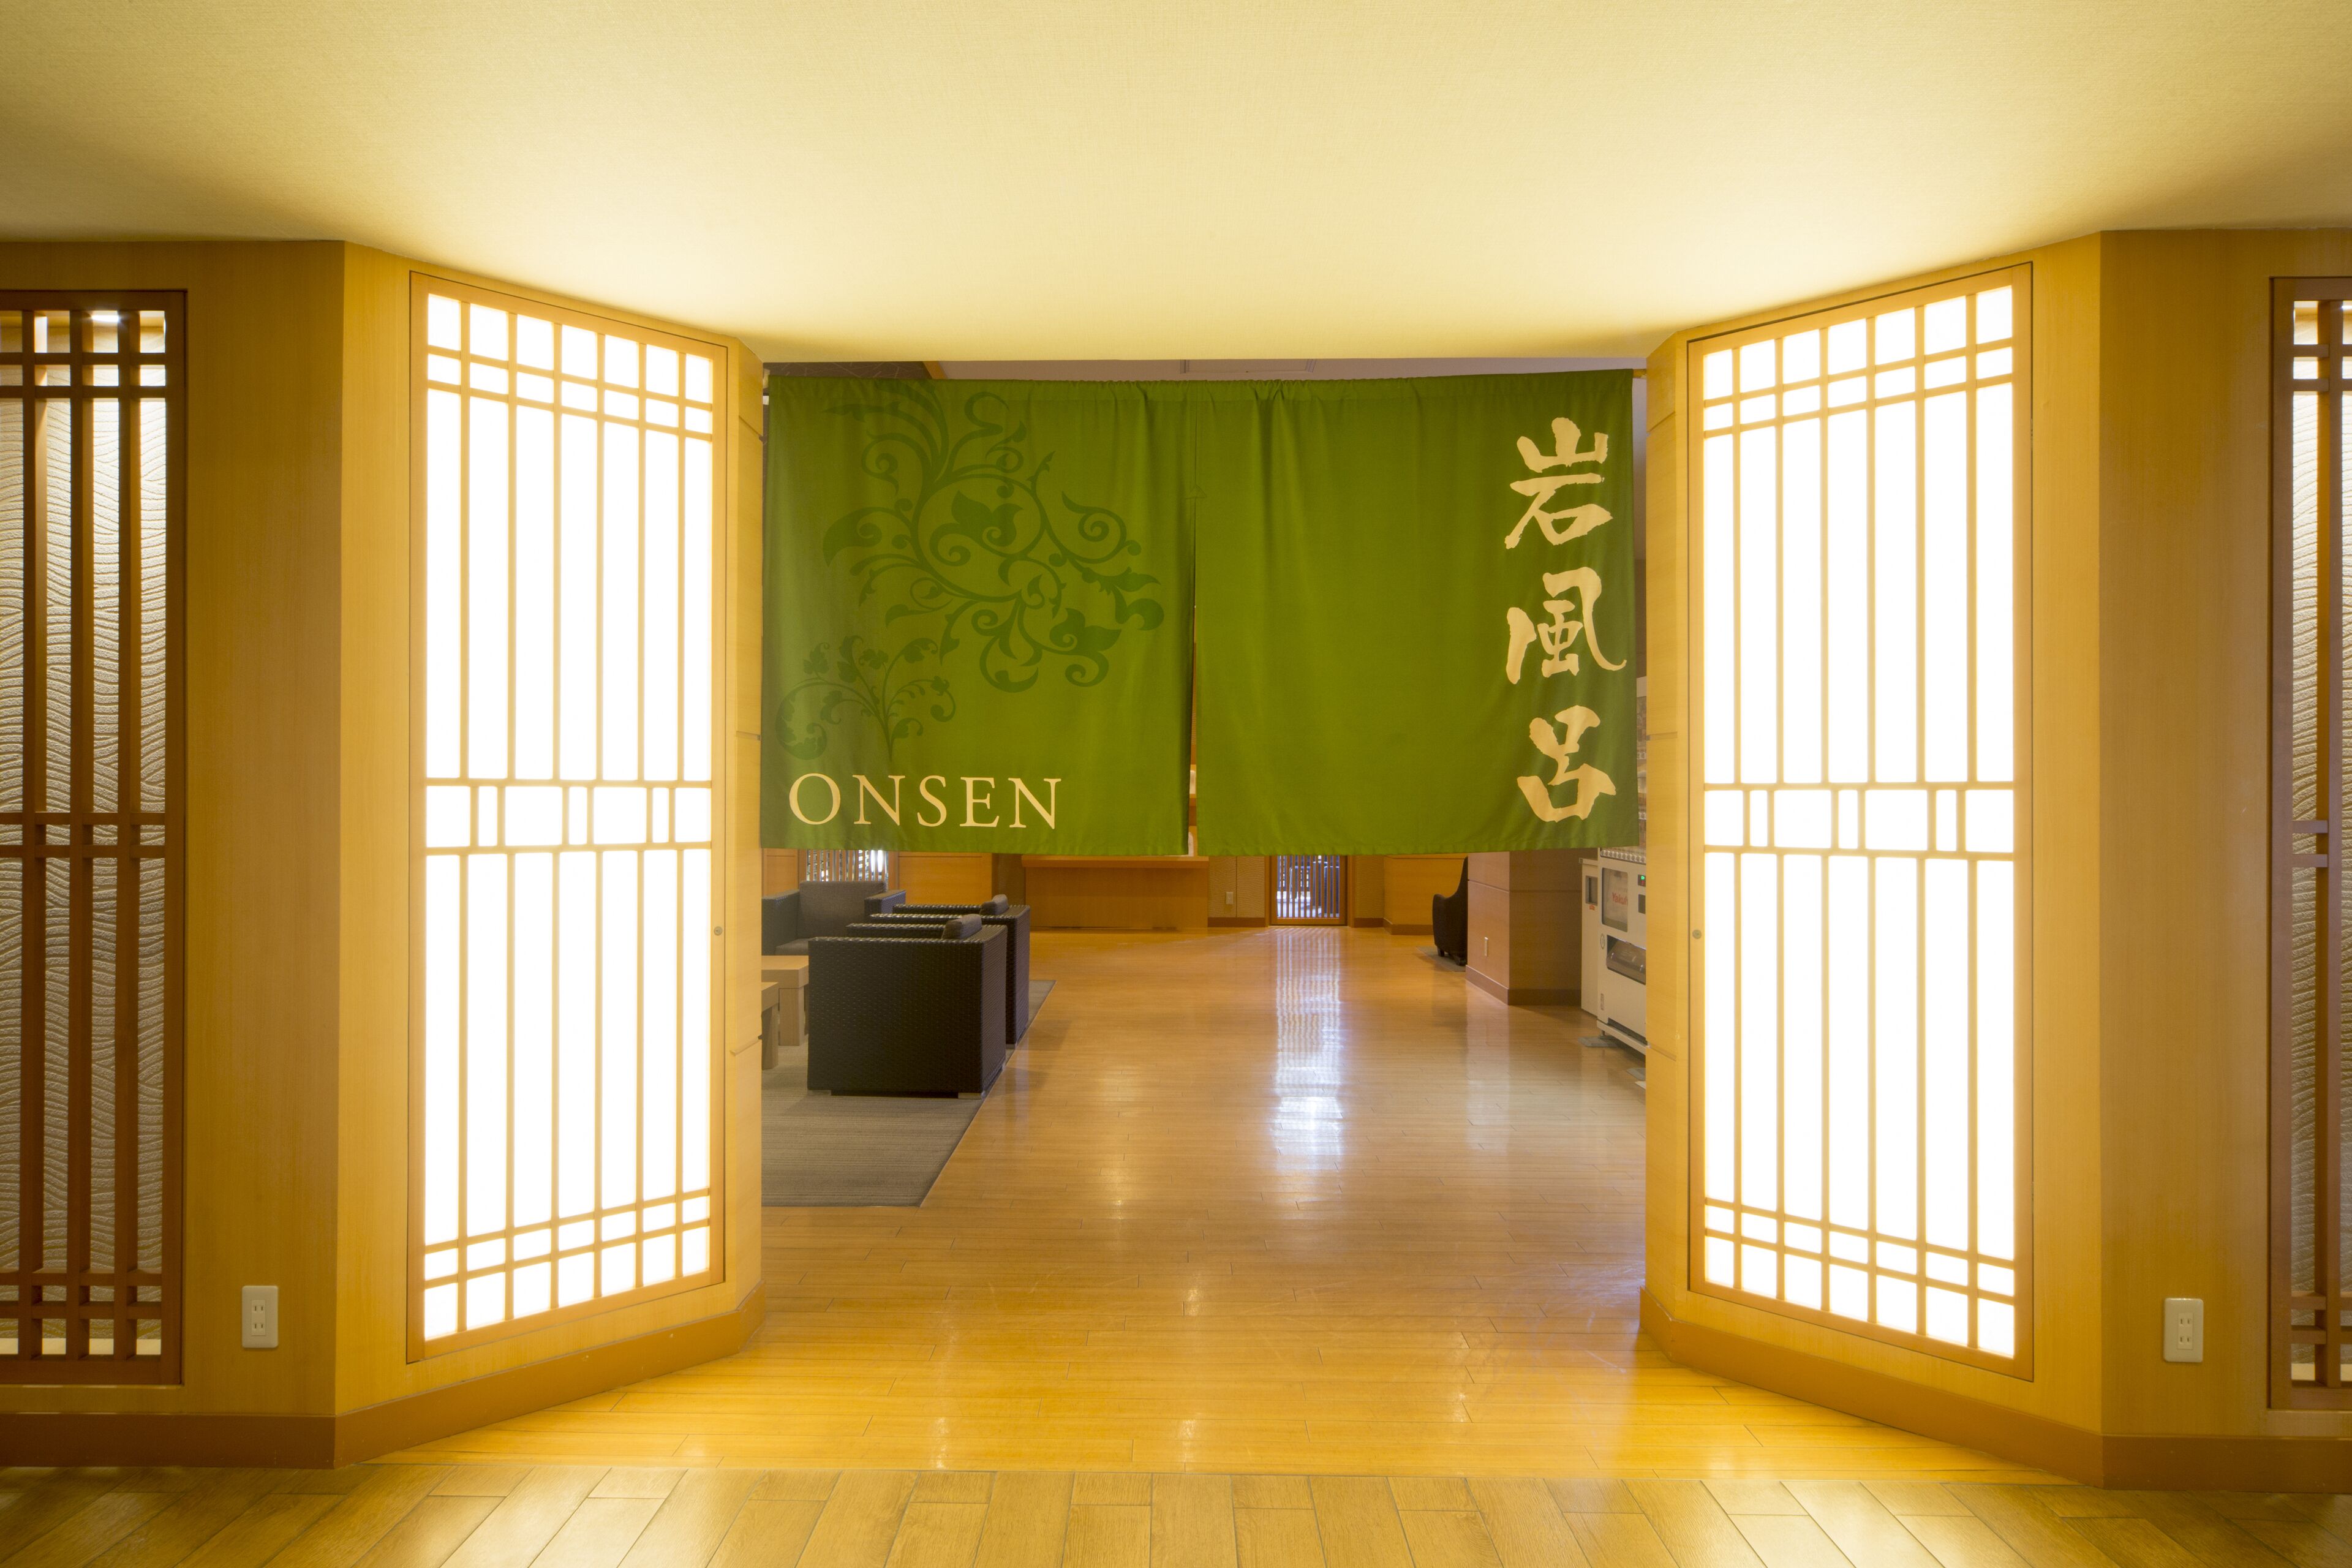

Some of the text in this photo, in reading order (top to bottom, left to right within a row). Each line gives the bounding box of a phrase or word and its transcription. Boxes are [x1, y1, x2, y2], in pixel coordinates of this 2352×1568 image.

[1504, 417, 1627, 823] 岩風呂
[789, 772, 1061, 829] ONSEN
